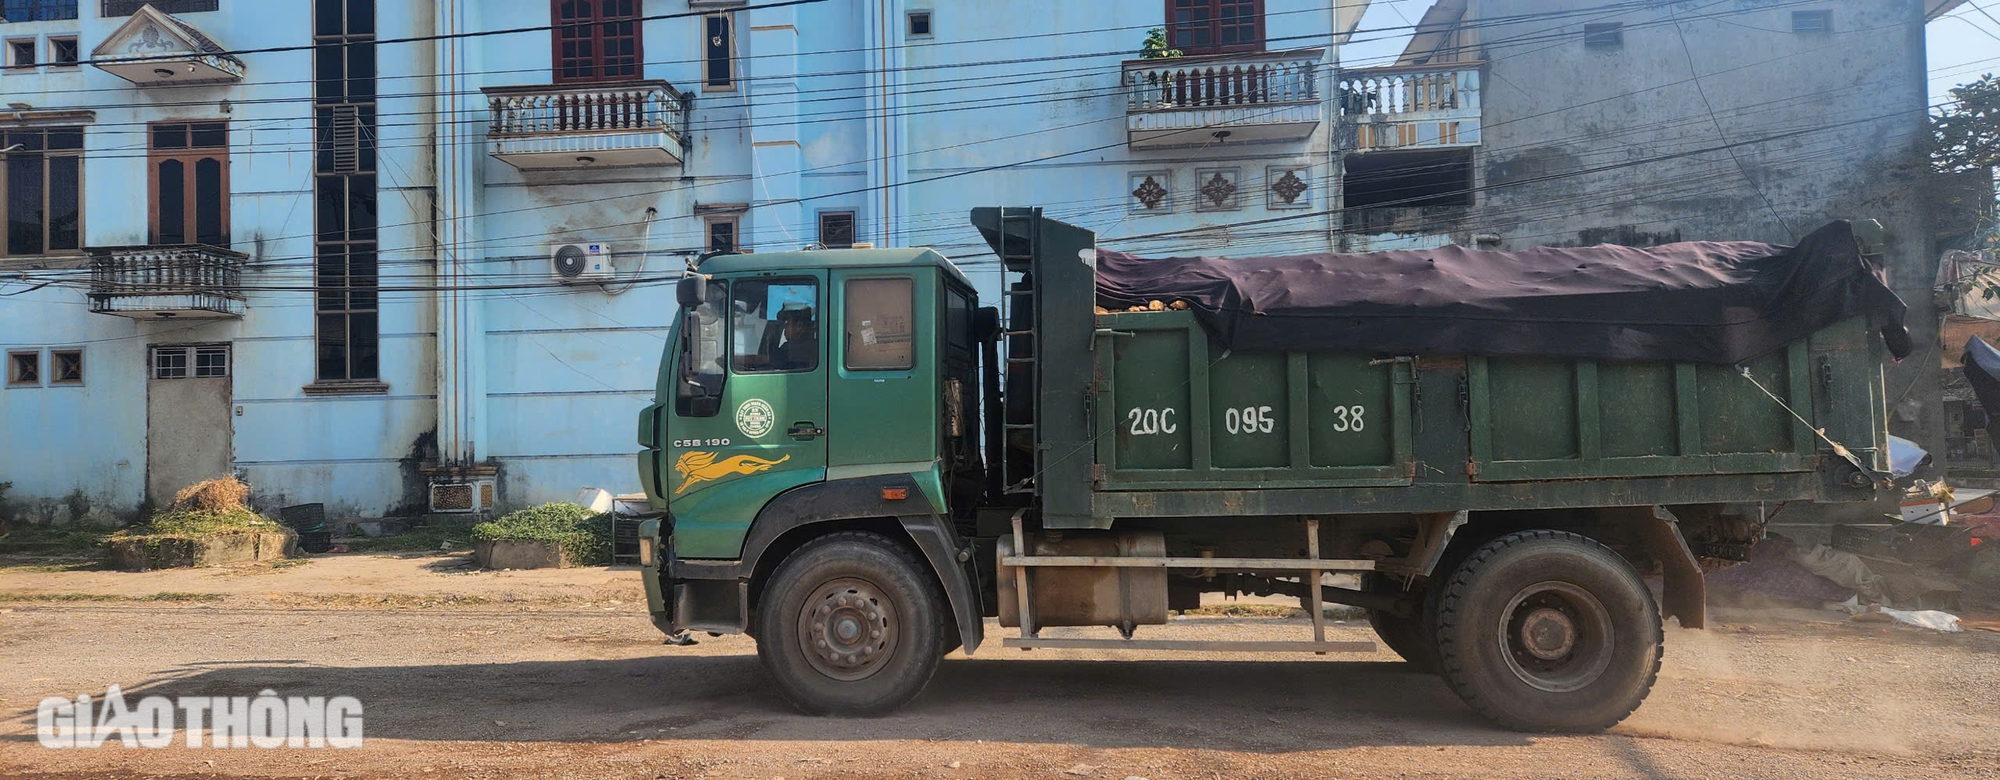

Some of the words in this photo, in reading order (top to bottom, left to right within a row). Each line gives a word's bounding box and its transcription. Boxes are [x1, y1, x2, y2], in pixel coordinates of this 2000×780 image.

[1128, 407, 1176, 435] 20C
[1225, 406, 1274, 434] 095
[1333, 405, 1365, 432] 38
[705, 438, 730, 446] 190
